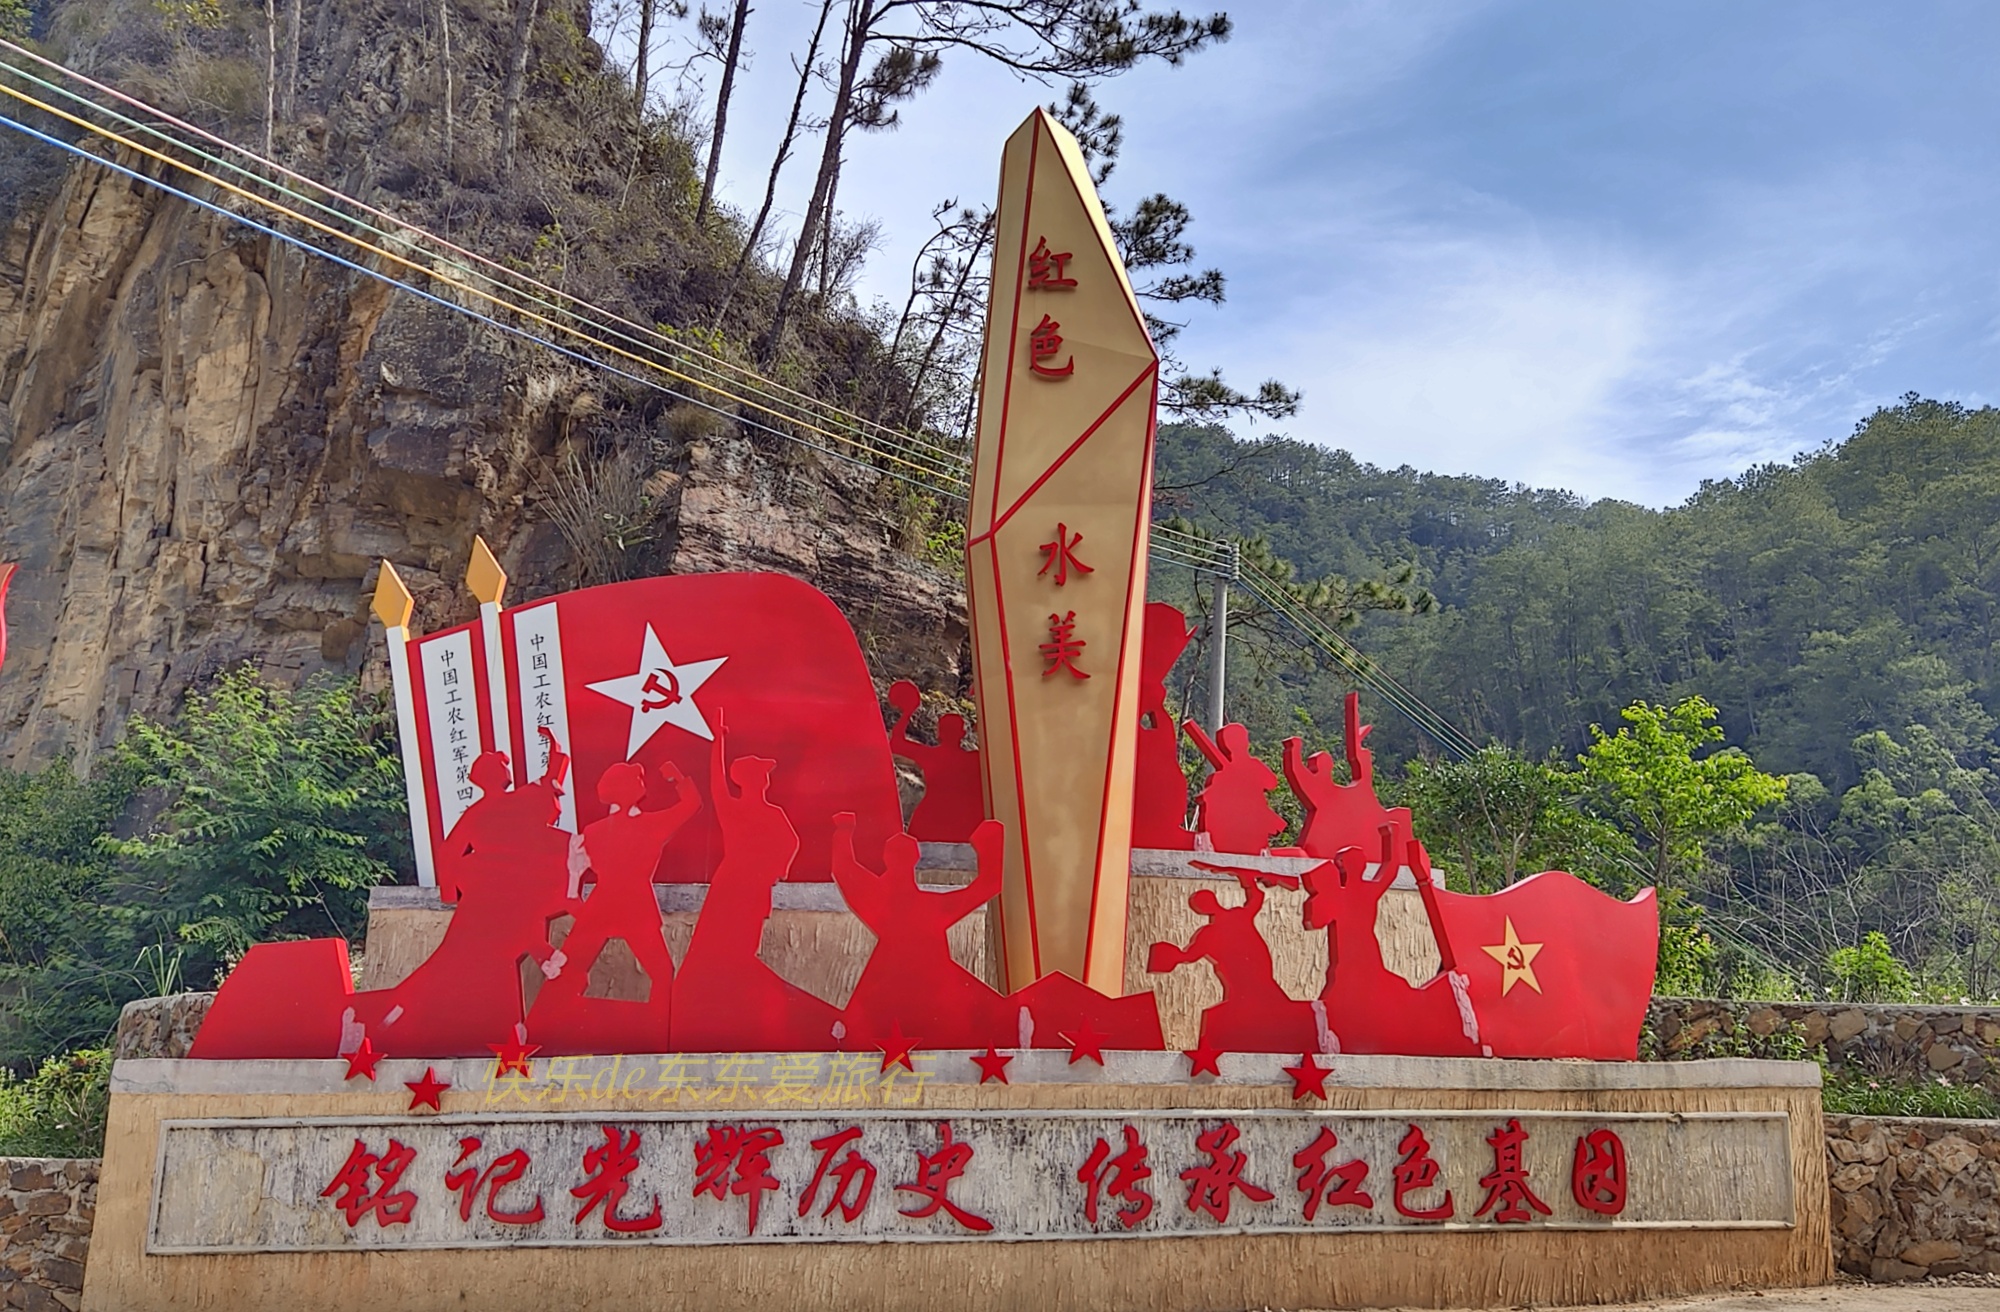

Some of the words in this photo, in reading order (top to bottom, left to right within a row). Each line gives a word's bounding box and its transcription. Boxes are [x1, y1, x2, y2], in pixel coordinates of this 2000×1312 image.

[1027, 236, 1078, 376] 红色
[1038, 522, 1095, 681] 水美
[441, 649, 474, 812] 中国工农红军第四
[321, 1121, 993, 1236] 铭记光辉历史
[1077, 1118, 1626, 1224] 传承红色基因
